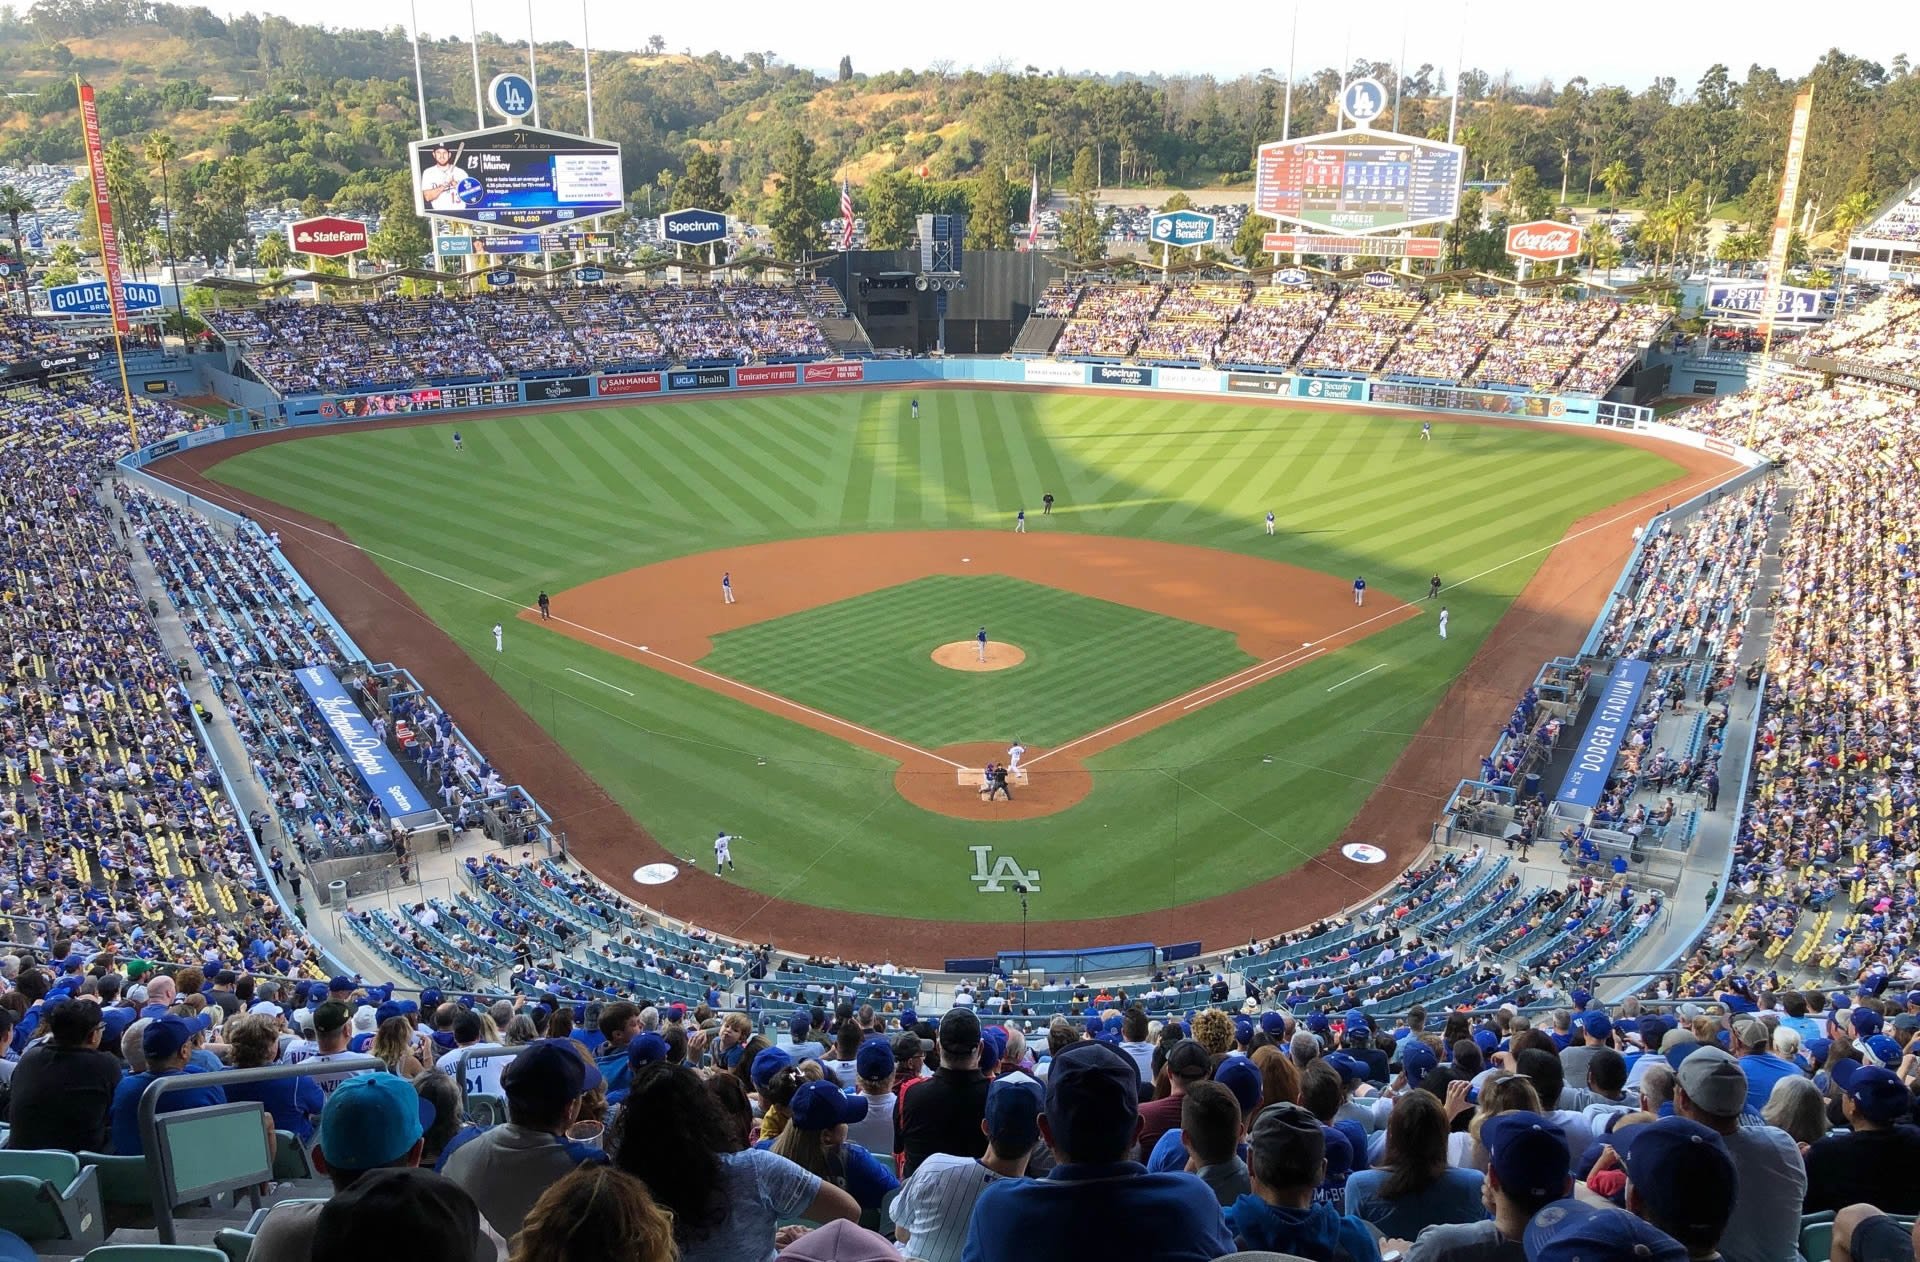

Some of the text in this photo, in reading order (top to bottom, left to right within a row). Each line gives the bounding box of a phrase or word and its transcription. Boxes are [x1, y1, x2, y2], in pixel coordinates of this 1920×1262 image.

[504, 81, 525, 110] LA
[1353, 85, 1374, 116] LA
[468, 154, 501, 169] 13 Max
[484, 162, 510, 171] Muncy
[92, 149, 109, 204] Emirates
[669, 220, 718, 234] Spectrum
[1176, 219, 1209, 231] Security
[1176, 229, 1204, 238] Benefit
[1512, 230, 1573, 252] Coca-Cola
[112, 270, 127, 320] Emirates
[1102, 368, 1139, 379] Spectrum
[1836, 363, 1849, 372] THE
[1850, 365, 1871, 376] LEXUS
[628, 376, 658, 385] MANUEL
[676, 375, 724, 385] UCLA Health
[739, 372, 768, 381] Emirates
[1324, 382, 1352, 392] Security
[1324, 390, 1347, 398] Benefit
[324, 405, 333, 413] 76
[1580, 726, 1616, 772] DODGER
[1600, 680, 1635, 723] STADIUM
[350, 737, 386, 775] Dodgers
[969, 846, 1041, 892] LA
